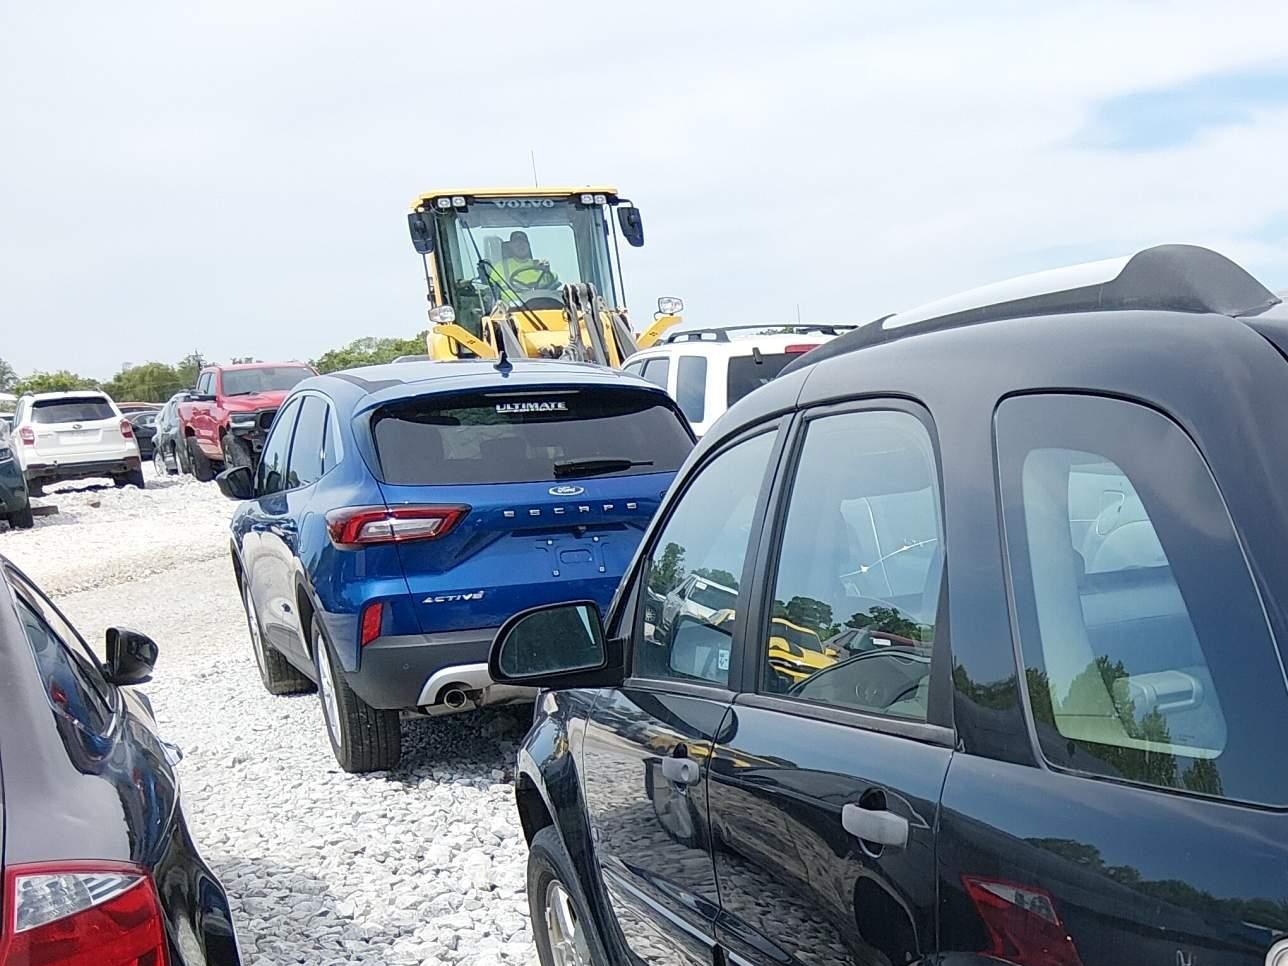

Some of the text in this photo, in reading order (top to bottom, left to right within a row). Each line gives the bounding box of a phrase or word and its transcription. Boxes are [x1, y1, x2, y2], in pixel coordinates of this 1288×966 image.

[495, 199, 555, 209] VOLVO
[495, 401, 566, 411] ULTIMATE
[421, 589, 485, 604] ACTIVE
